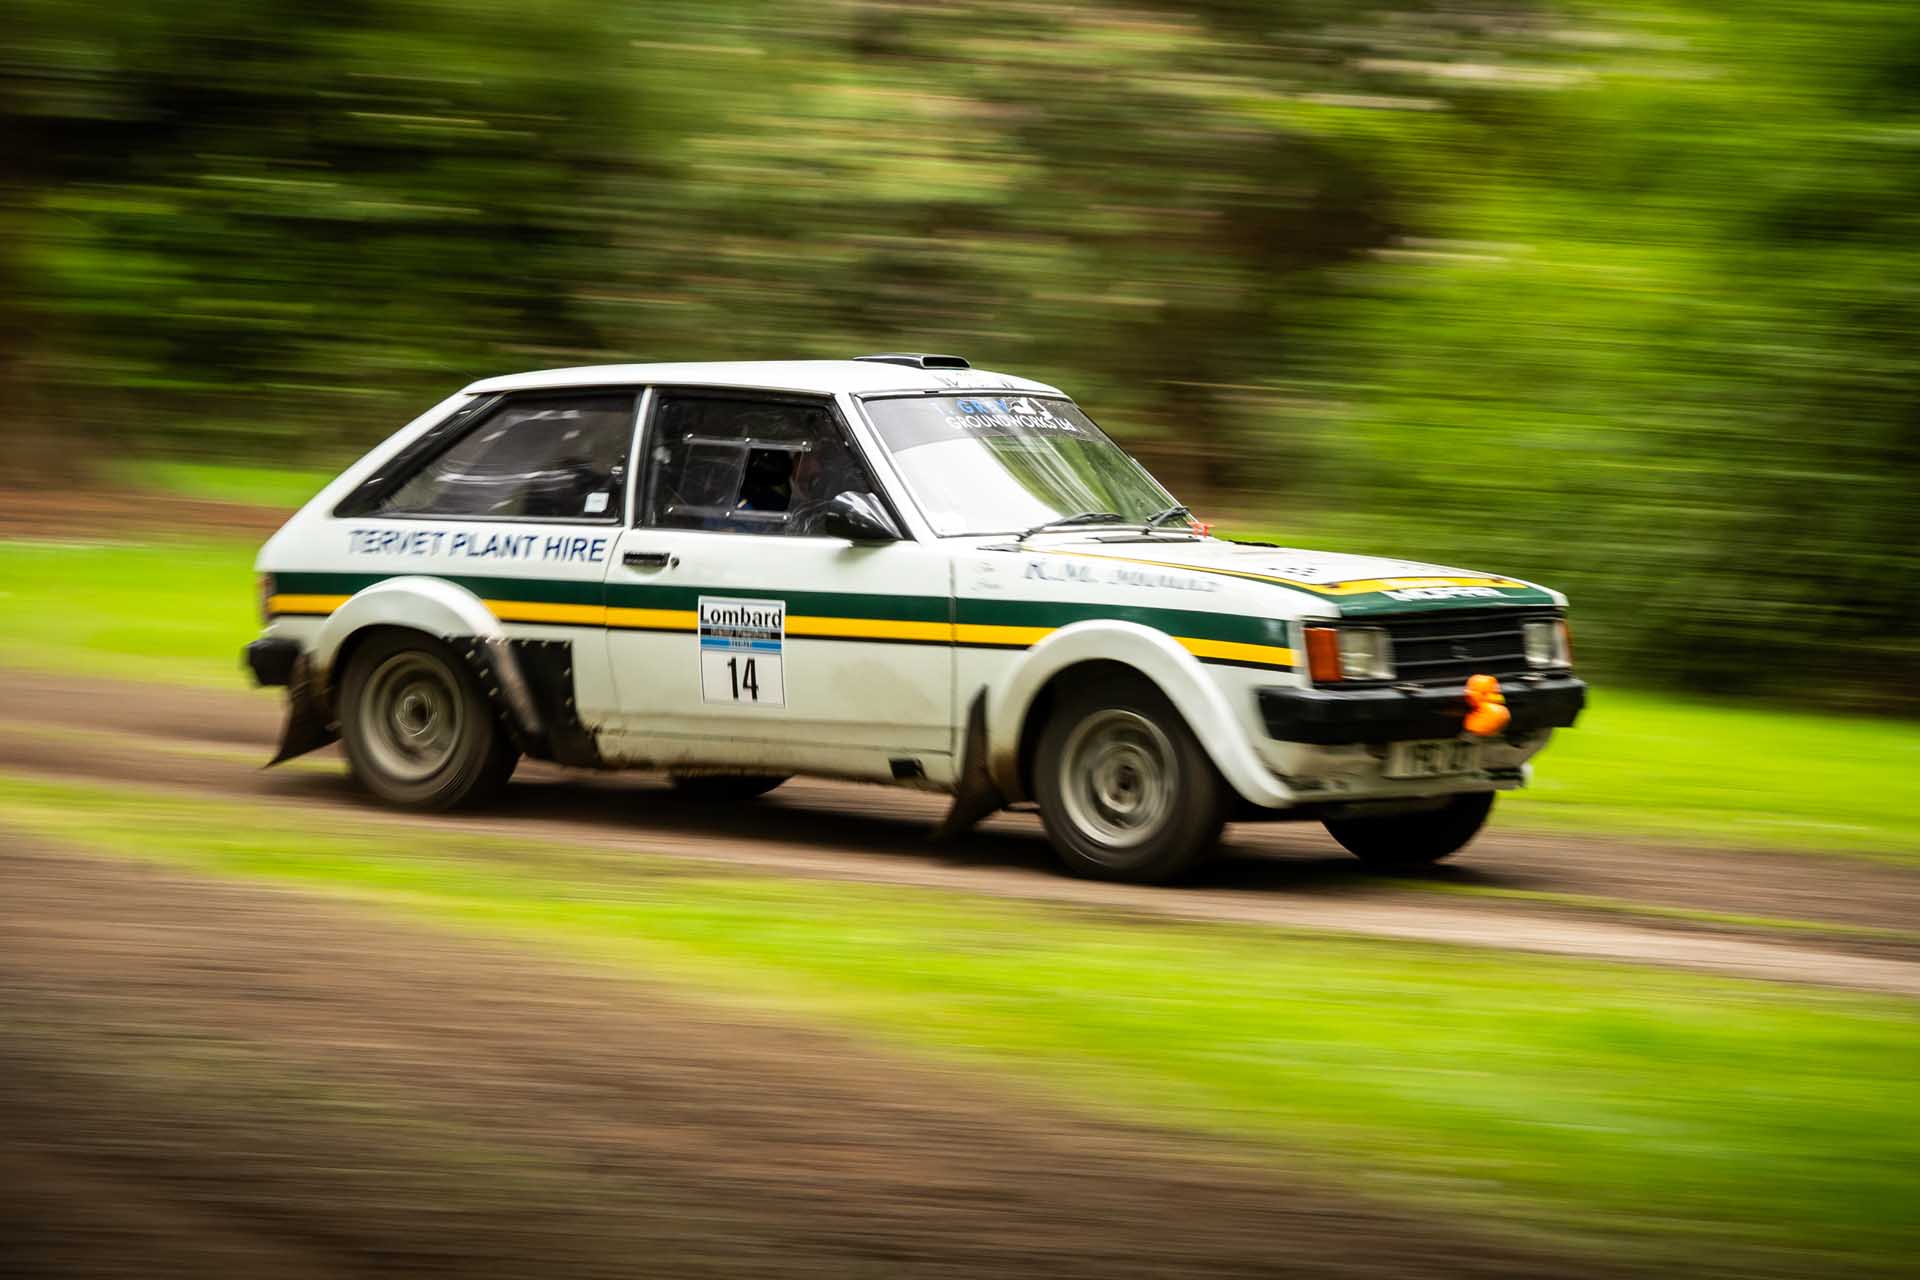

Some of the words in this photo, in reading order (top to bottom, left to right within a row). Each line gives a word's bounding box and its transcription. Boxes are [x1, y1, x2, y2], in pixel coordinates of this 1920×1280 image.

[945, 414, 1057, 430] GROUNDWORKS
[349, 529, 447, 555] TERVET
[450, 532, 537, 558] PLANT
[542, 535, 607, 562] HIRE
[700, 604, 782, 628] Lombard
[727, 657, 759, 701] 14
